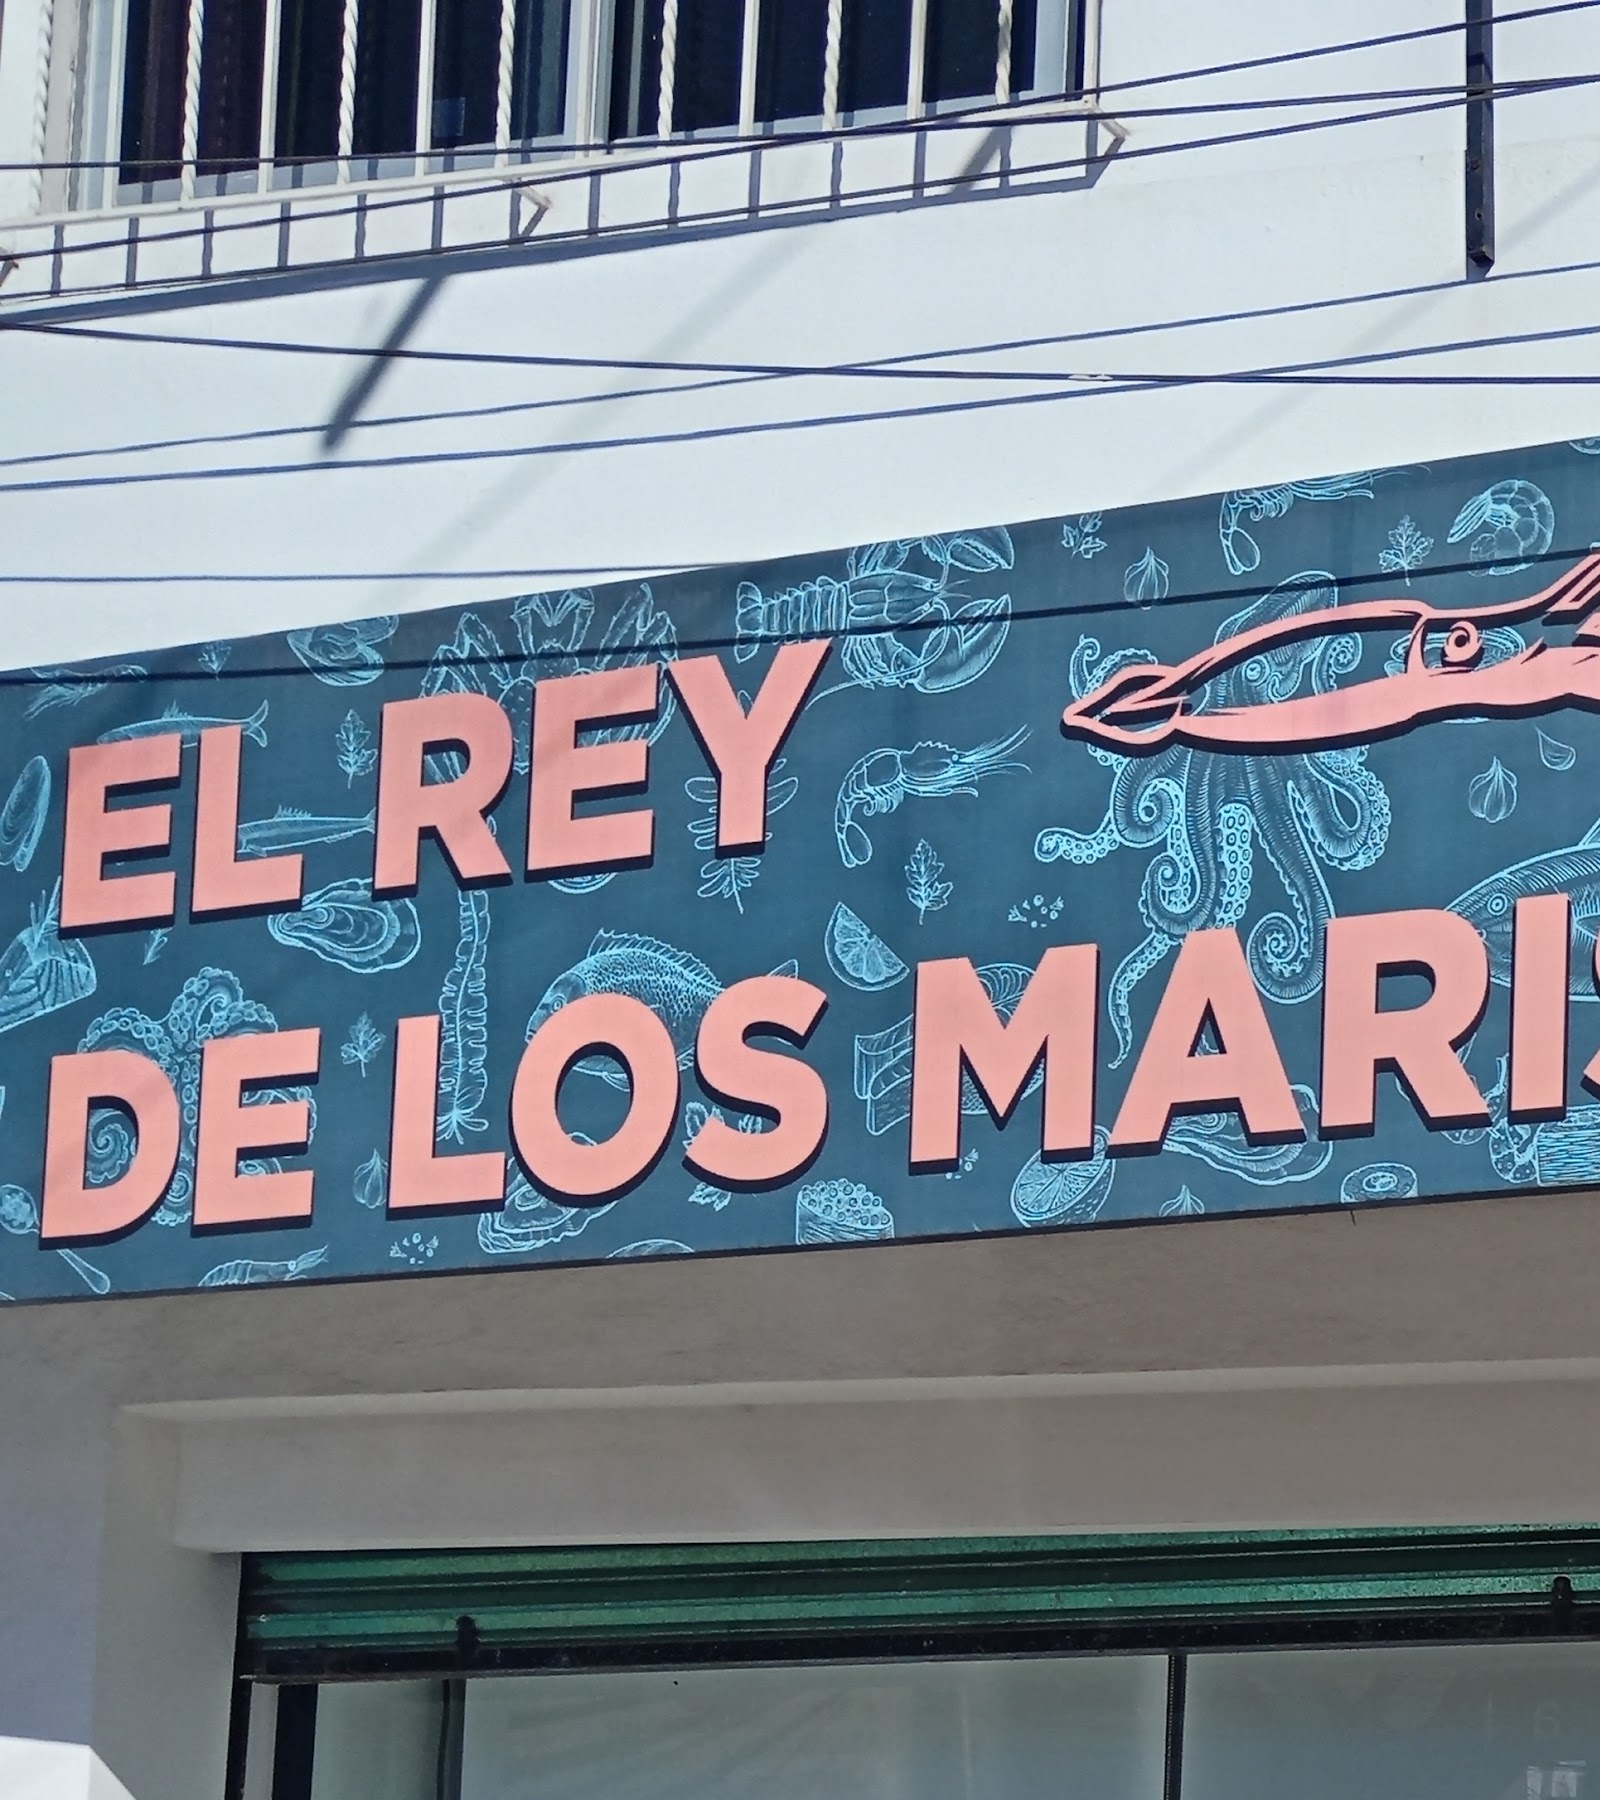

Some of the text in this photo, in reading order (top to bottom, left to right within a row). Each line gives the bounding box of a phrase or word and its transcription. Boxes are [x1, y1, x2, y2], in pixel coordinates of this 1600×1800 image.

[62, 641, 828, 926] EL REY
[42, 1029, 319, 1237] DE
[390, 976, 826, 1207] LOS
